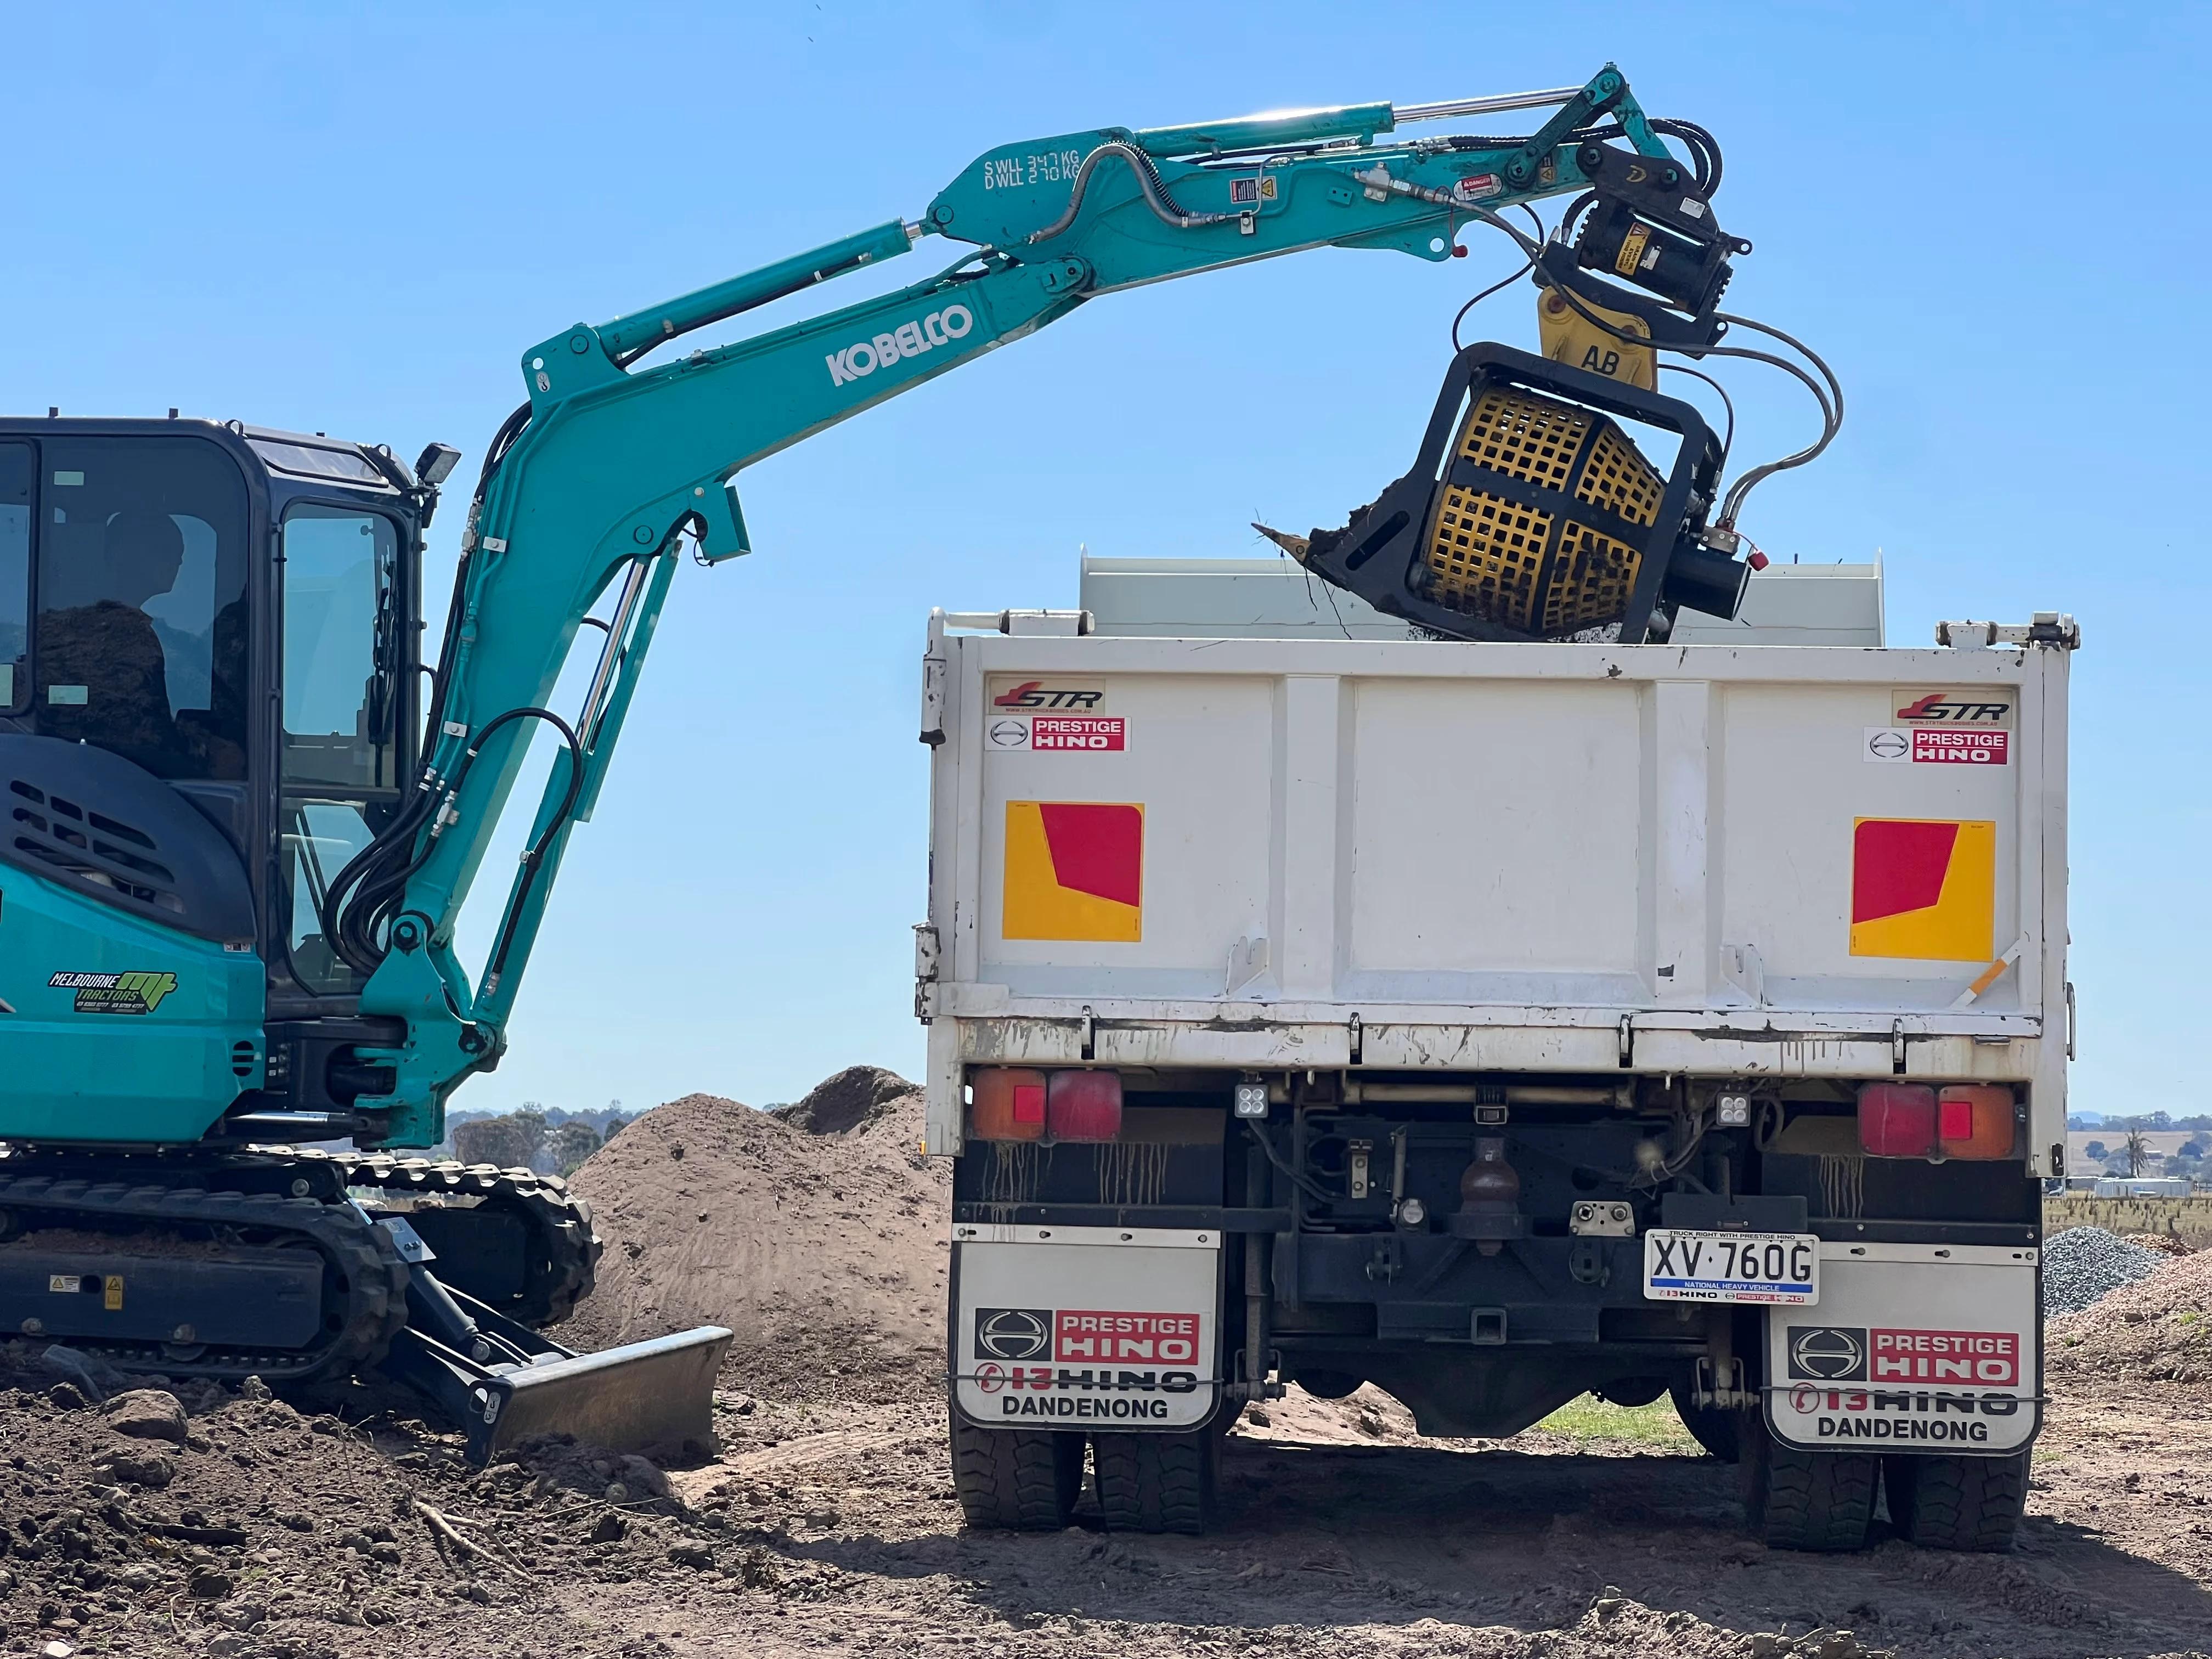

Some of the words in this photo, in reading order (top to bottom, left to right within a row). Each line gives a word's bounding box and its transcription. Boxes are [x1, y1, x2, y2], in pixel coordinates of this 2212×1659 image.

[985, 161, 993, 175] S
[995, 158, 1023, 174] WLL
[1028, 153, 1058, 168] 347
[1061, 150, 1079, 165] KG
[985, 176, 994, 189] D
[996, 171, 1024, 188] WLL
[1028, 167, 1059, 183] 270
[1063, 165, 1080, 179] KG
[825, 304, 973, 387] KOBELCO
[1581, 345, 1620, 376] AB
[1001, 691, 1104, 708] STR
[1904, 703, 2010, 720] STR
[1036, 720, 1121, 733] PRESTIGE
[1035, 736, 1108, 748] HINO
[1916, 733, 2004, 746] PRESTIGE
[1916, 748, 1990, 762] HINO
[49, 973, 121, 988] MELBOURNE
[77, 989, 139, 1001] TRACTORS
[1062, 1316, 1193, 1334] PRESTIGE
[1062, 1337, 1192, 1360] HINO
[1877, 1335, 2012, 1354] PRESTIGE
[1877, 1356, 2012, 1381] HINO
[1003, 1396, 1168, 1418] DANDENONG
[1818, 1417, 1988, 1441] DANDENONG
